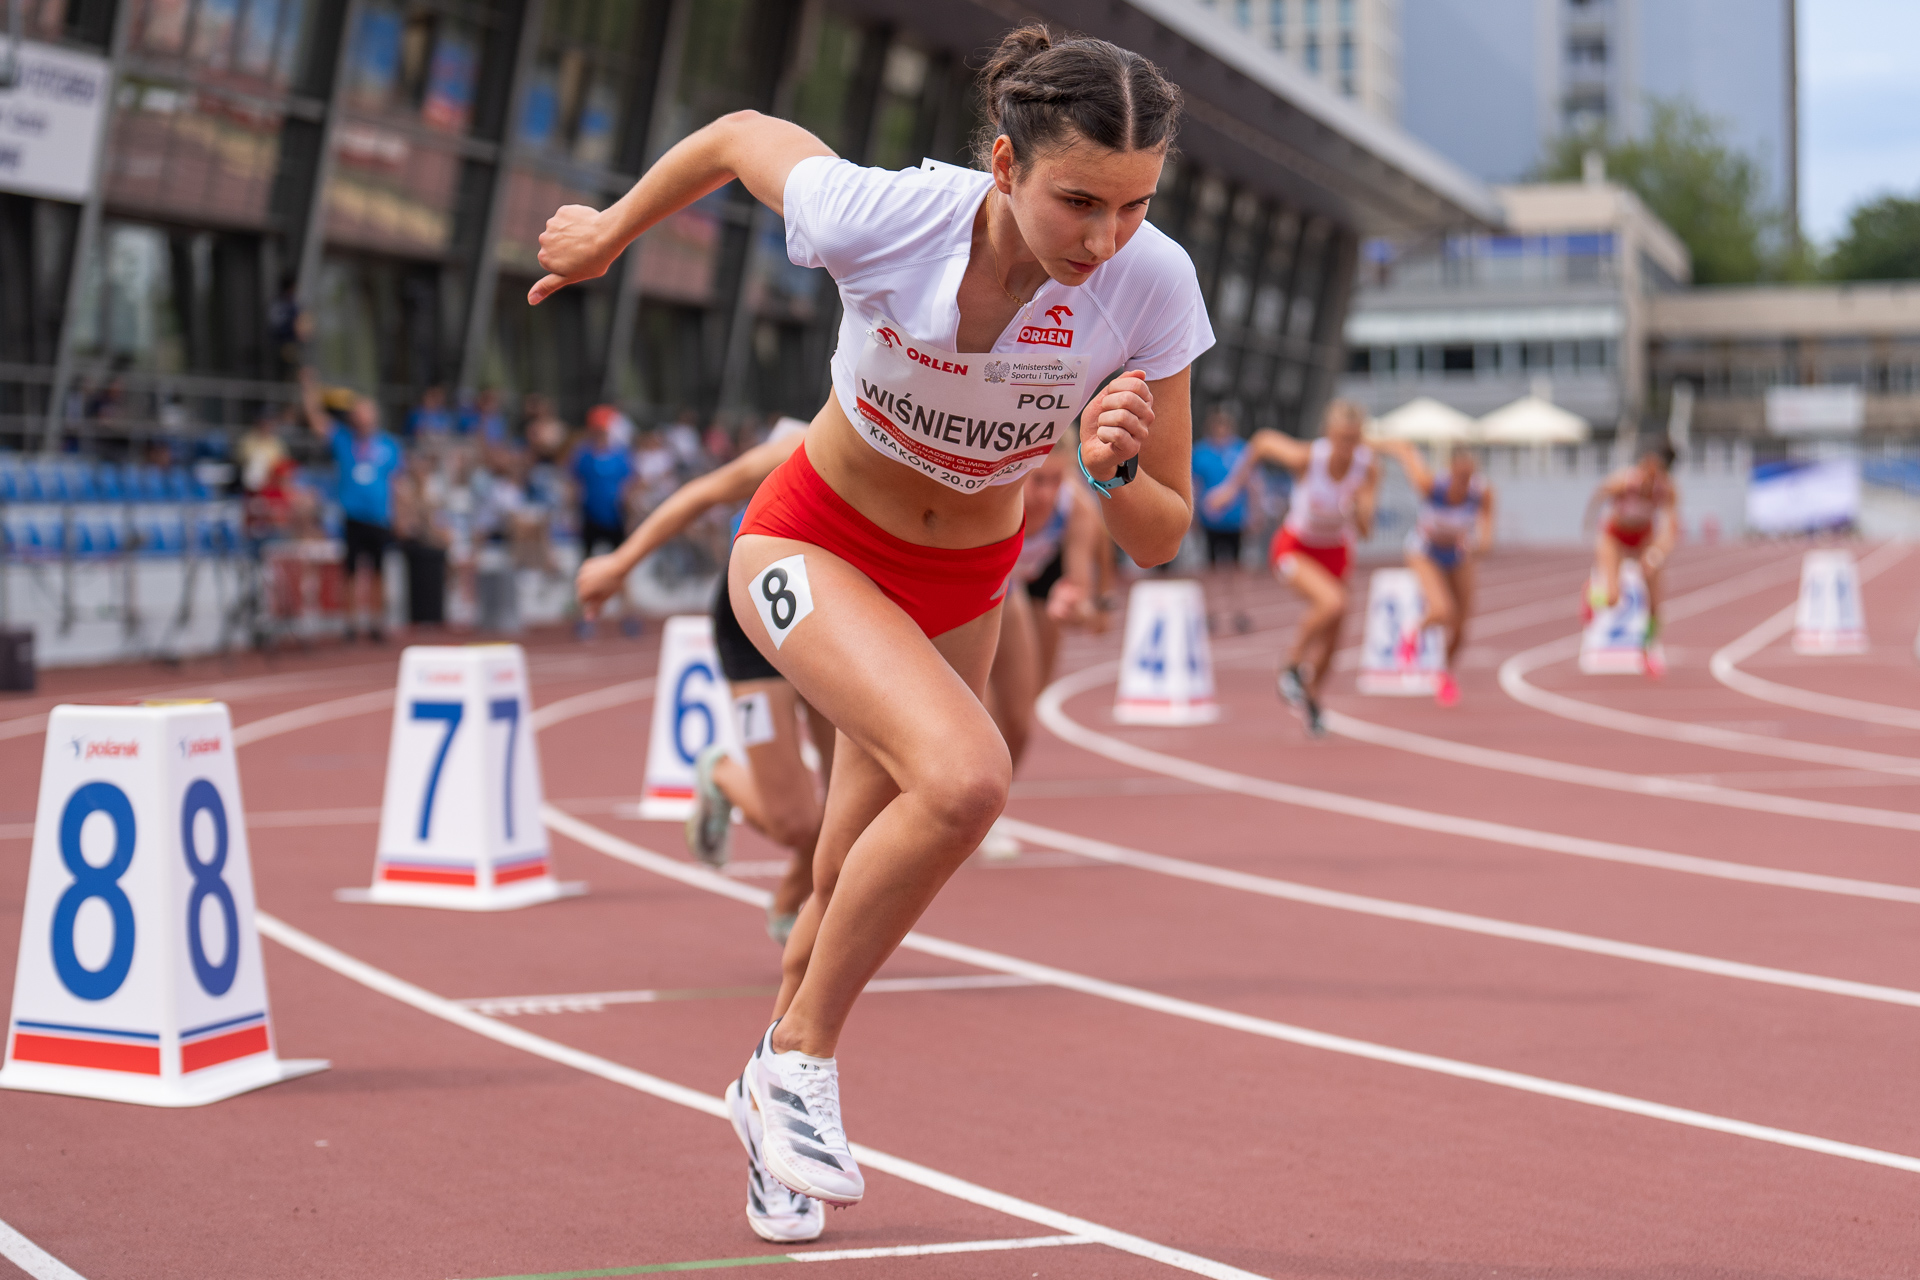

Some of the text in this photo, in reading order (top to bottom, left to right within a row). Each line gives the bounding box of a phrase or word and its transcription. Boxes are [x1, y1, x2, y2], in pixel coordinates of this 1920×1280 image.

[906, 347, 969, 376] ORLEN
[1020, 328, 1069, 345] ORLEN
[1011, 372, 1037, 380] Sportu
[1044, 372, 1078, 381] Turystyki
[1012, 363, 1063, 371] Ministerstwo
[861, 378, 1055, 452] WIŚNIEWSKA
[1017, 394, 1070, 410] POL
[860, 407, 881, 424] MECZ
[881, 422, 951, 467] LEKKOATLETYCZNY
[951, 463, 971, 473] U23
[870, 426, 1023, 489] KRAKÓW 20.07.2024
[891, 424, 921, 449] TURNIEJ
[922, 446, 955, 462] NADZIEI
[762, 567, 797, 630] 8
[1137, 617, 1165, 674] 4
[673, 661, 716, 768] 6
[410, 698, 519, 843] 7 7
[49, 777, 240, 1003] 8 8
